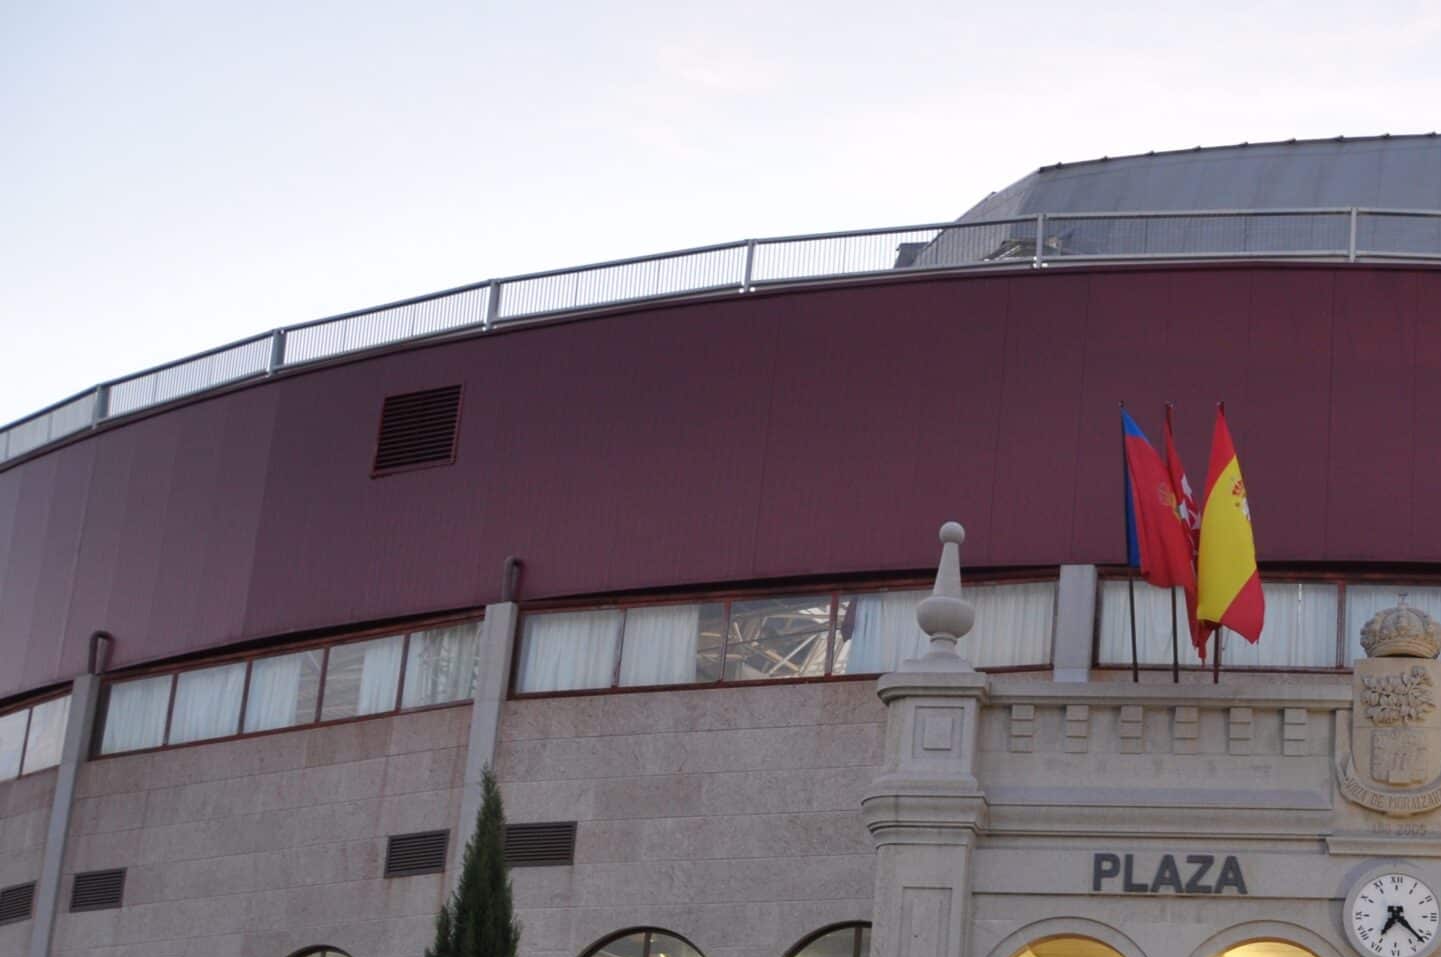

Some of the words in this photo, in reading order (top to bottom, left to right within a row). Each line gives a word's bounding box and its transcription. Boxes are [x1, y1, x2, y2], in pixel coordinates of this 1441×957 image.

[1093, 853, 1248, 894] PLAZA
[1391, 876, 1404, 884] XII
[1430, 912, 1438, 922] III
